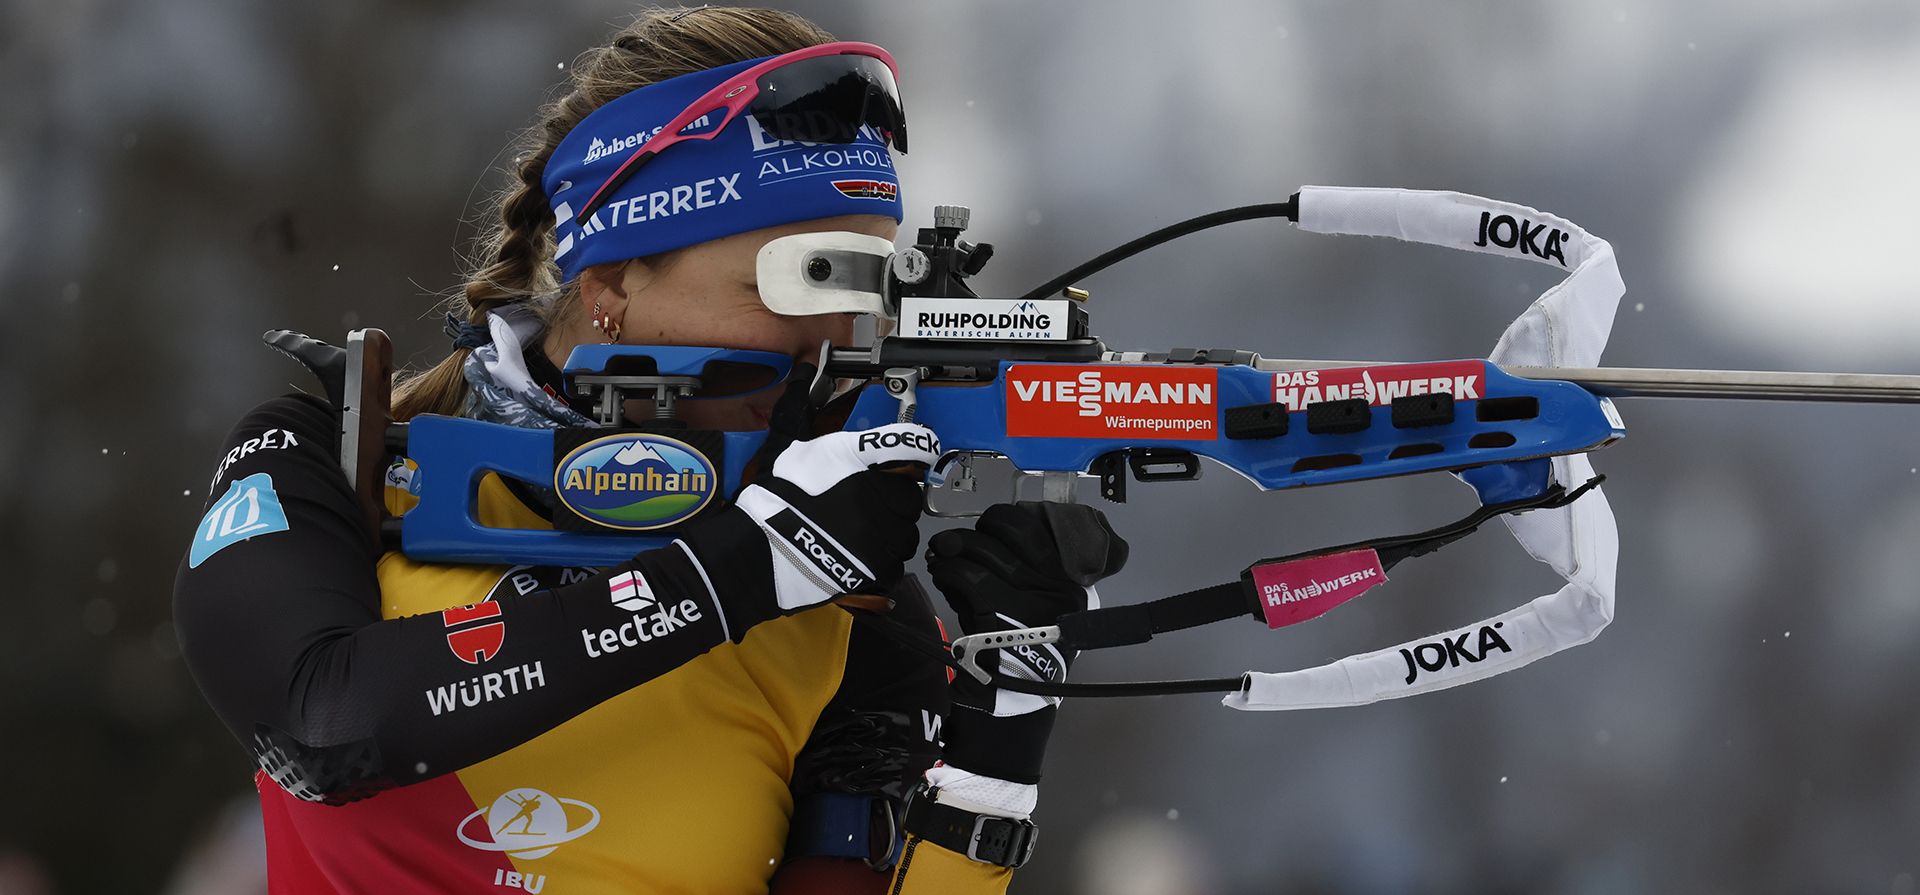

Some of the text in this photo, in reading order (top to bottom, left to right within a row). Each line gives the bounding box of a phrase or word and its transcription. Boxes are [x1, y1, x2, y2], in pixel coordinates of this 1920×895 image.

[608, 173, 742, 228] TERREX
[918, 312, 1051, 330] RUHPOLDING
[917, 330, 1051, 339] BAYERISCHE ALPEN
[1276, 370, 1319, 387] DAS
[1012, 371, 1212, 417] VIESSMANN
[1105, 415, 1212, 432] Wärmepumpen
[564, 466, 707, 492] Alpenhain
[1263, 582, 1288, 594] DAS
[581, 598, 702, 658] tectake
[494, 868, 547, 895] IBU
